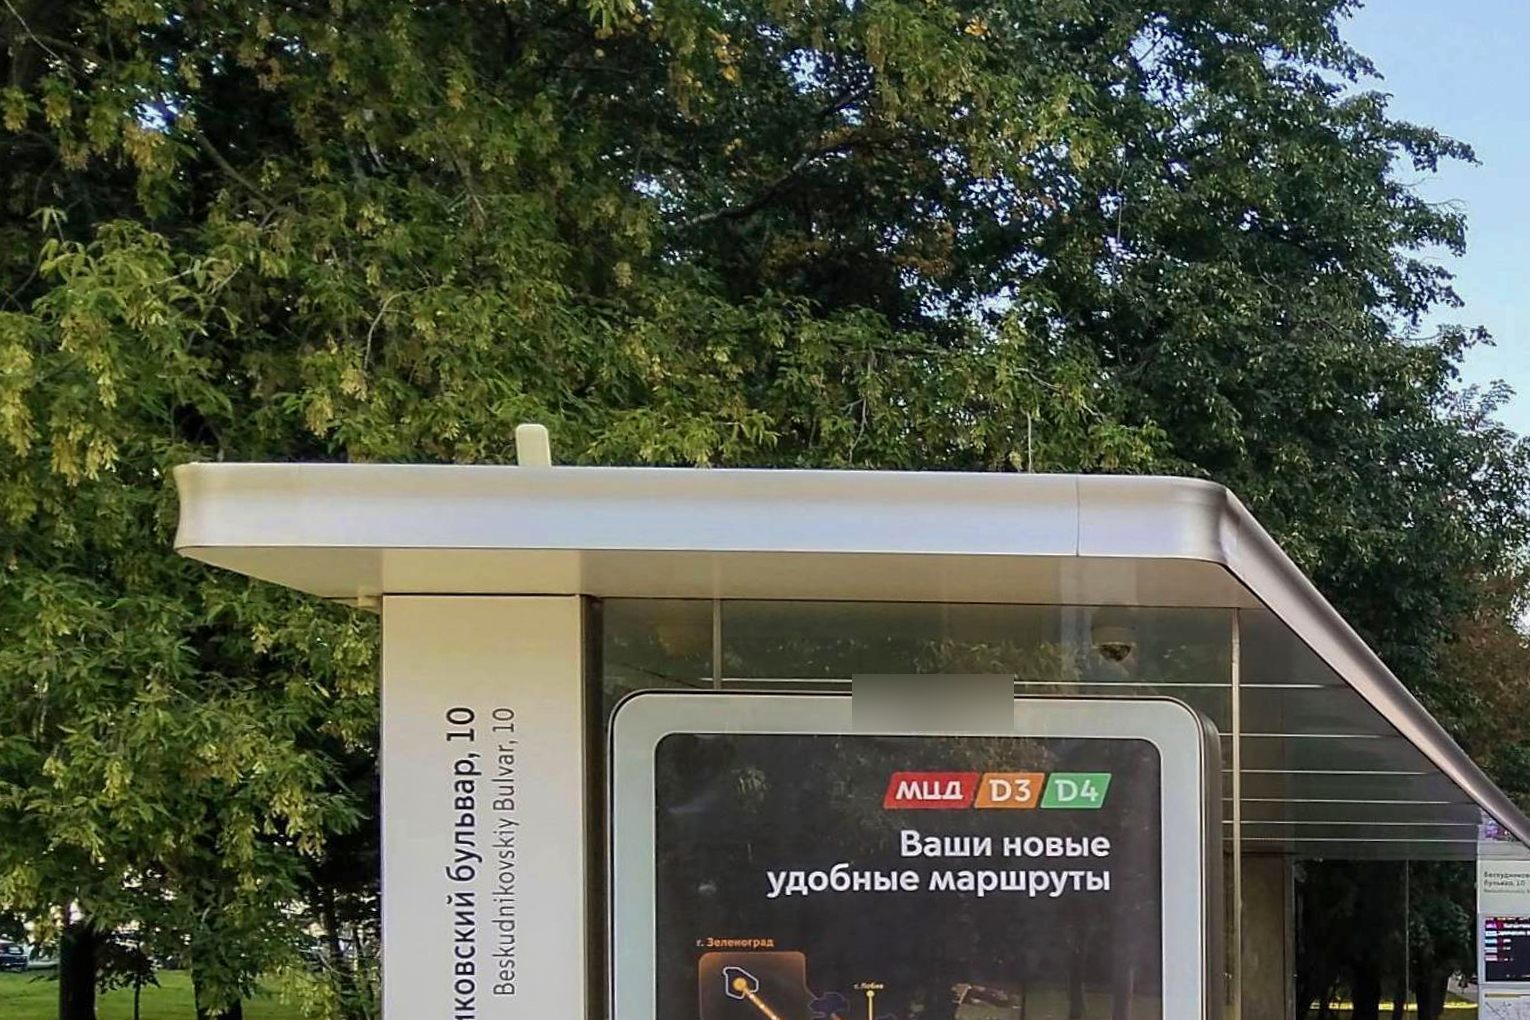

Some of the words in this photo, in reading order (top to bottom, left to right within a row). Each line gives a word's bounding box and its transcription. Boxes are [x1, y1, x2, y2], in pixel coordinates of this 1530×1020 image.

[446, 706, 476, 742] 10
[492, 708, 516, 734] 10
[491, 740, 518, 811] Bulvar,
[895, 780, 964, 800] МЦД
[988, 779, 1031, 802] D3
[1054, 779, 1100, 802] D4
[445, 752, 482, 882] бульвар,
[900, 829, 993, 857] Ваши
[1003, 836, 1111, 858] новые
[767, 862, 919, 897] удобные
[928, 869, 1111, 898] маршруты
[491, 817, 519, 996] Beskudnikovskiy
[706, 937, 775, 949] Зеленоград
